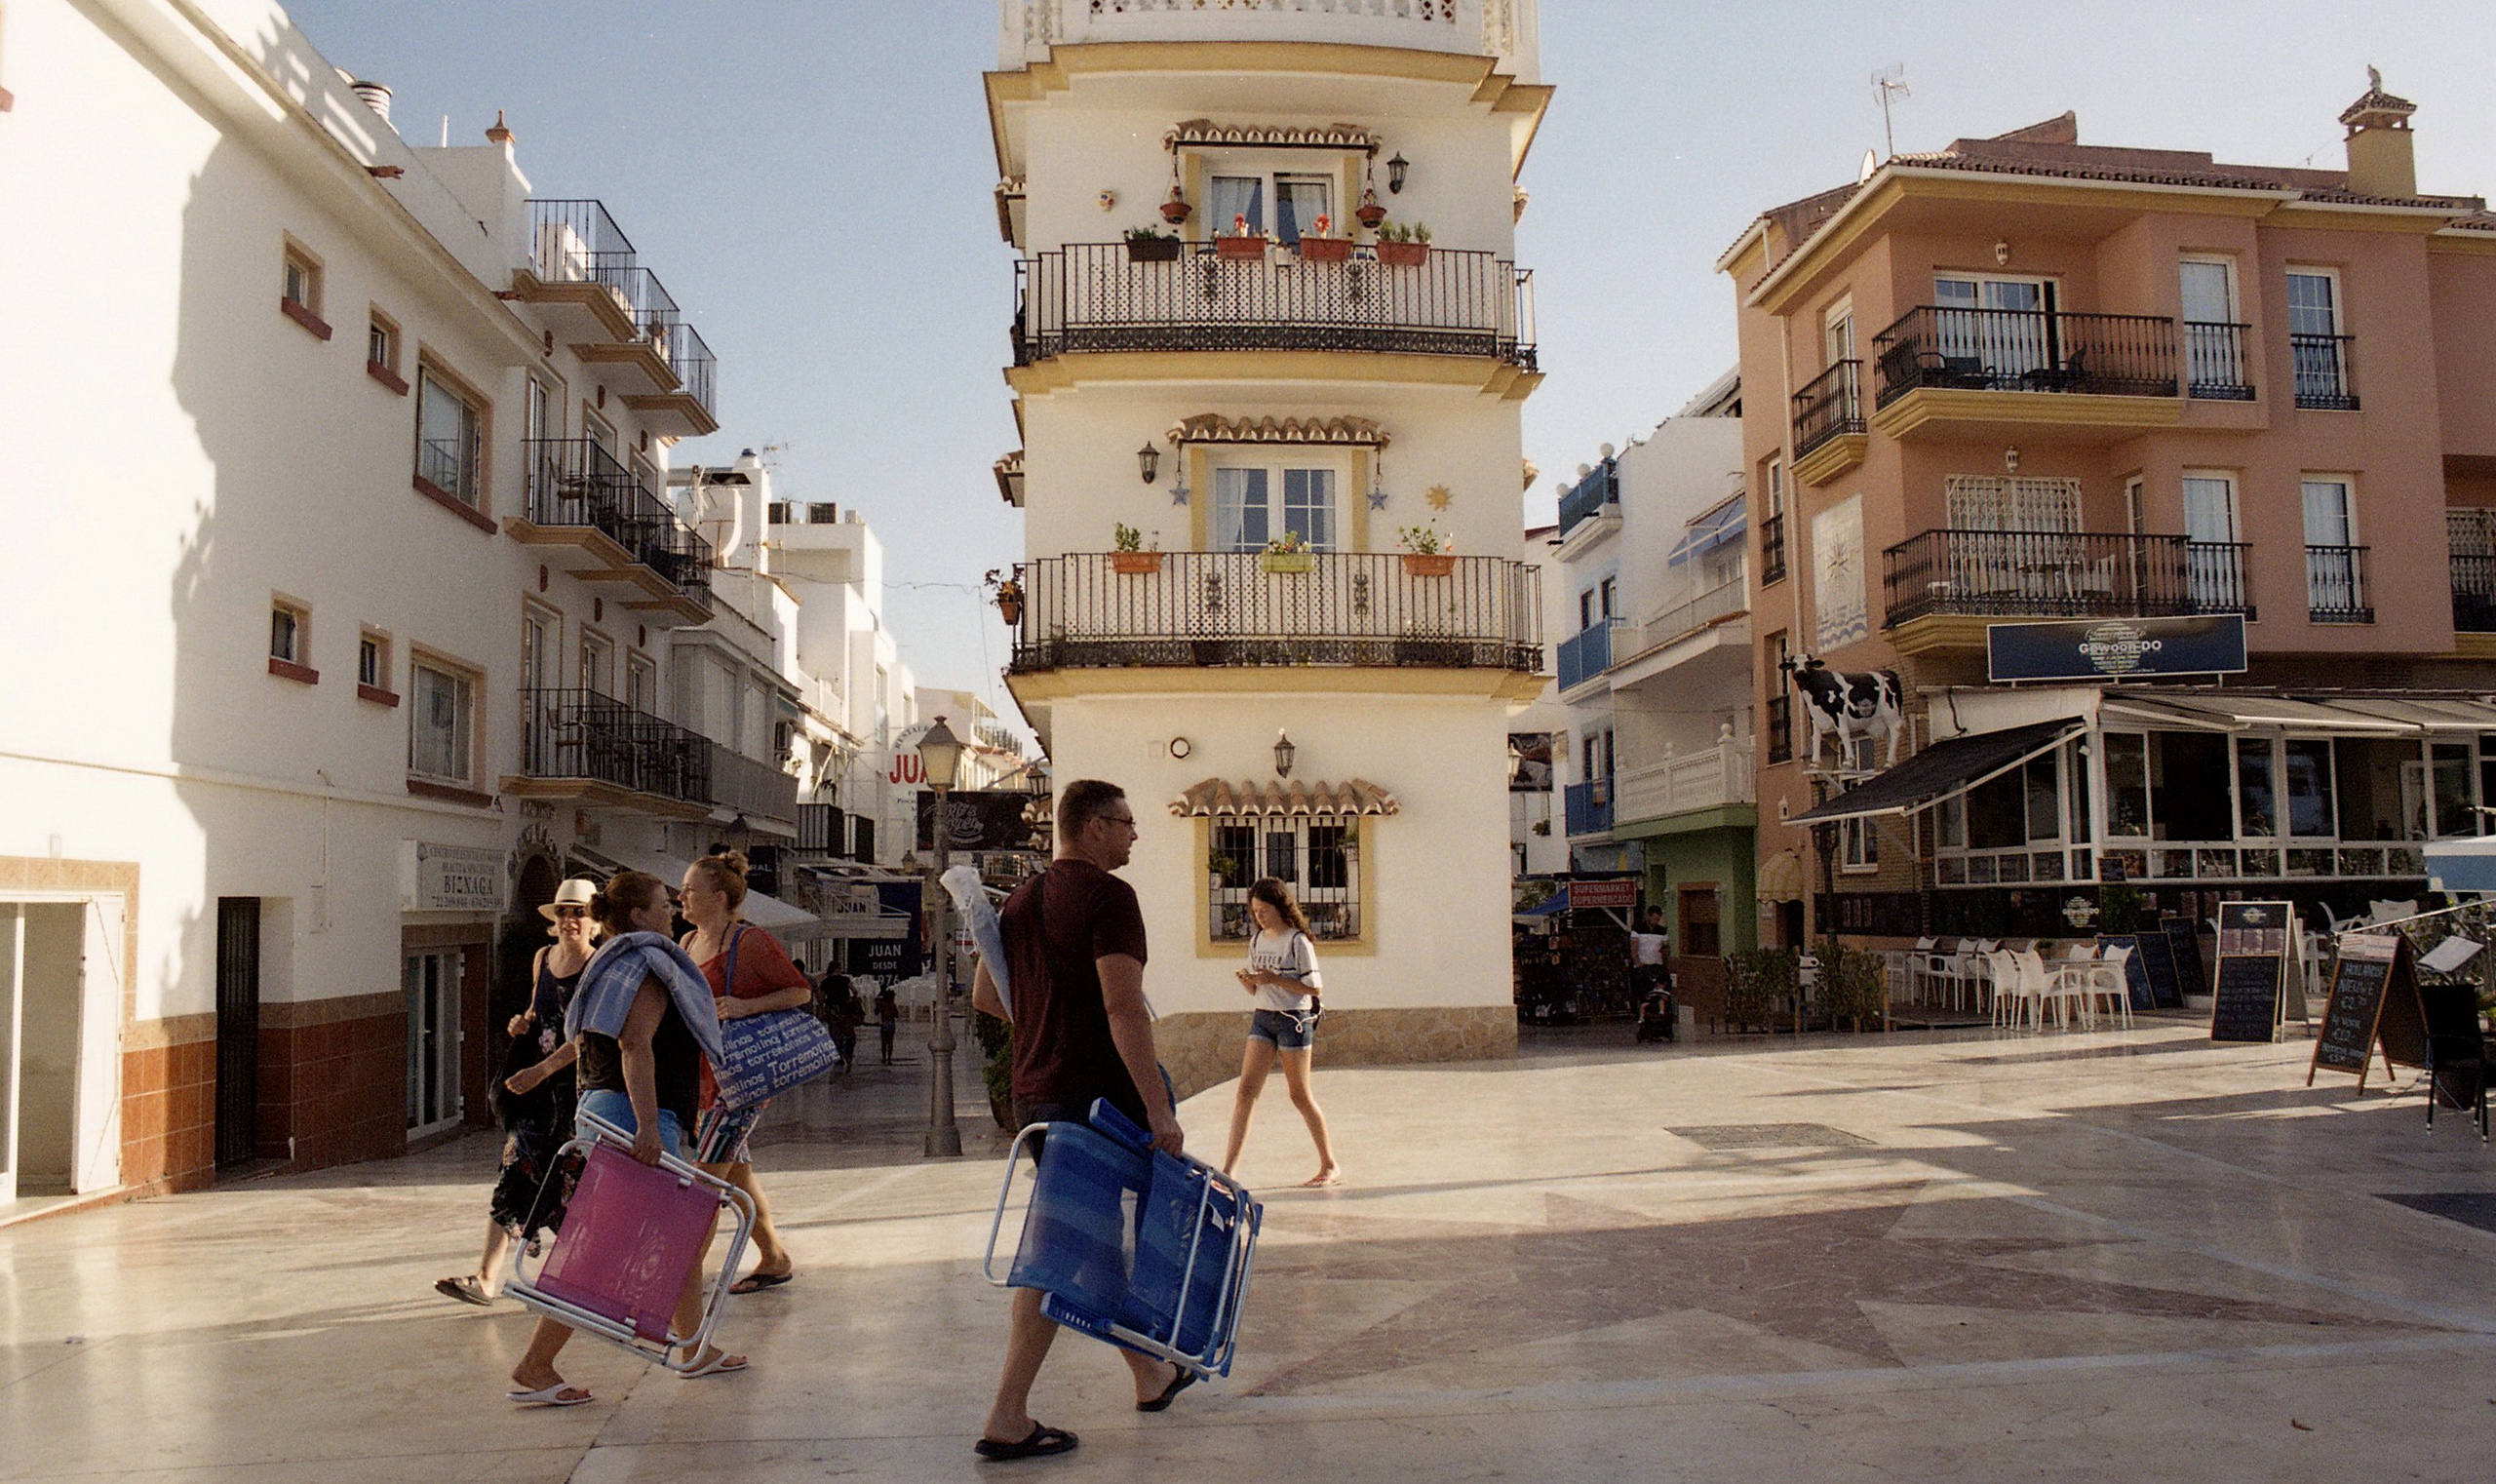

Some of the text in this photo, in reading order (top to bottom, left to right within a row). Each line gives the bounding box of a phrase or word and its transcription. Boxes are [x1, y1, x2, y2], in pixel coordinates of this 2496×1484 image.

[2141, 640, 2163, 651] DO
[895, 725, 930, 750] RESTAUR
[444, 875, 493, 895] BIZNAGA
[1574, 882, 1630, 894] SUPERMARKET
[1572, 894, 1634, 906] SUPERMERCADO
[837, 902, 867, 914] JUAN
[868, 944, 902, 957] JUAN
[873, 961, 897, 970] DESDE
